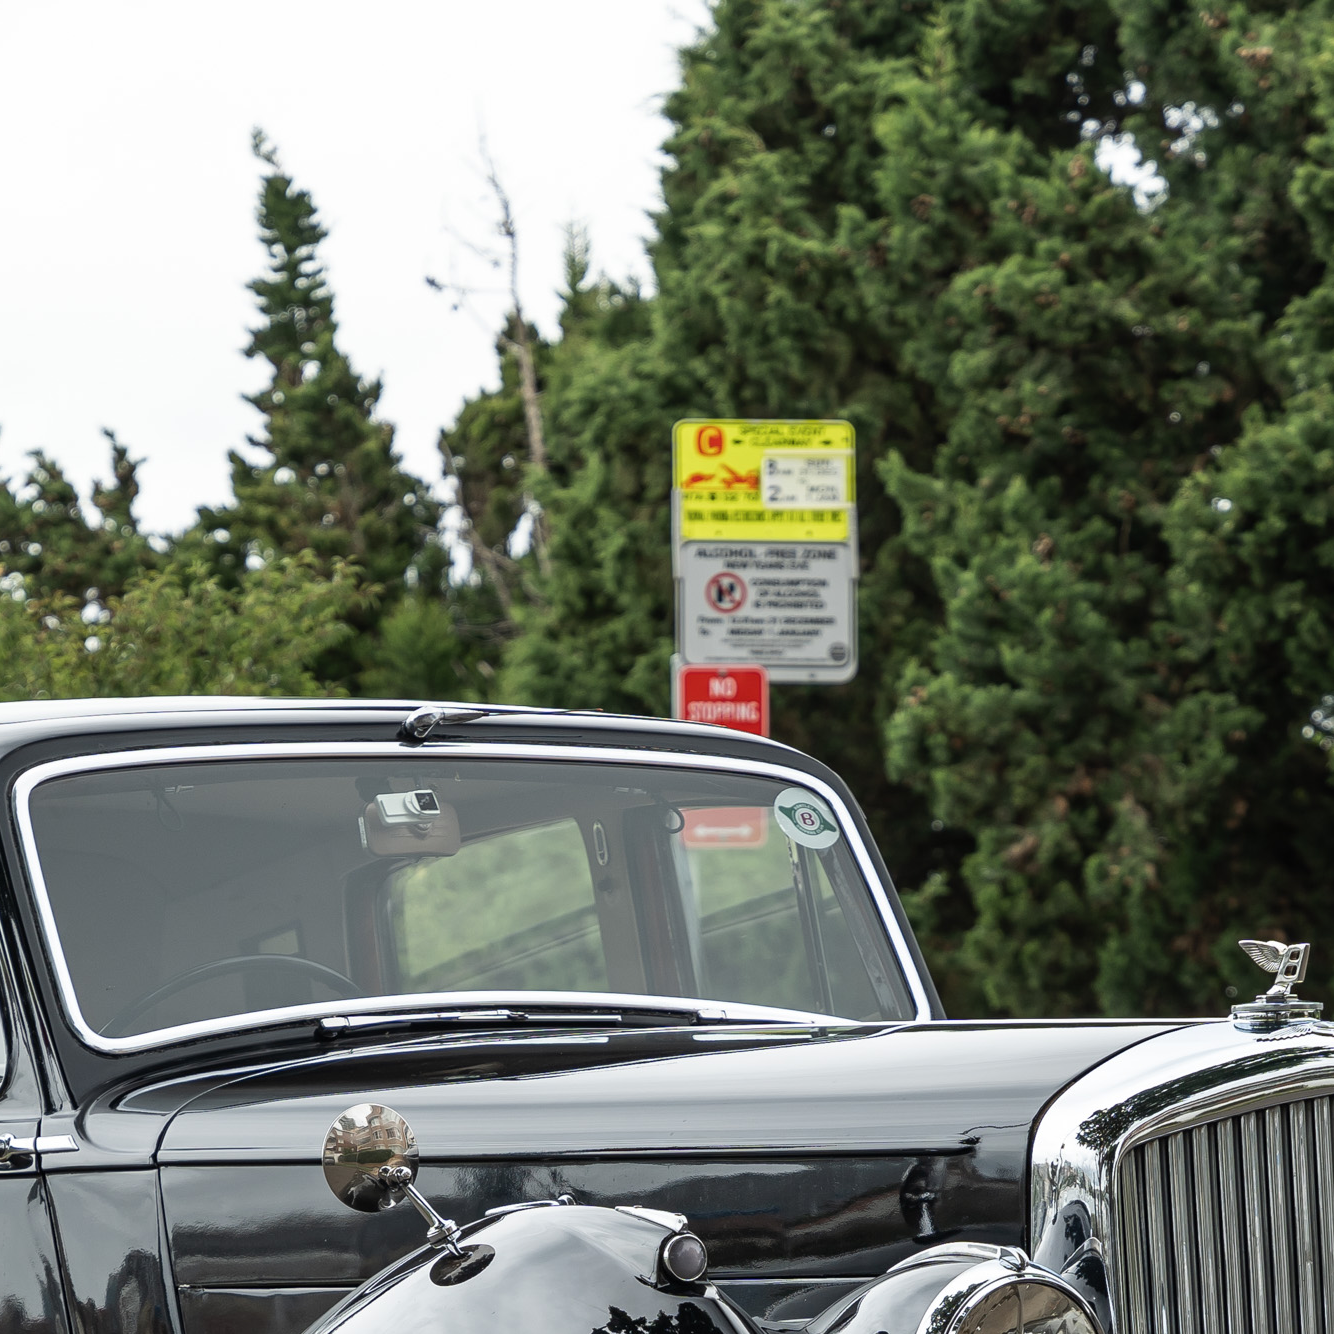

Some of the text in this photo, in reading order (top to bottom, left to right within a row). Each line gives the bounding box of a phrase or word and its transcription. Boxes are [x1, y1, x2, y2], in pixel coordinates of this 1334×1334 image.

[709, 677, 738, 699] NO
[688, 701, 760, 723] STOPPING
[800, 812, 815, 826] B
